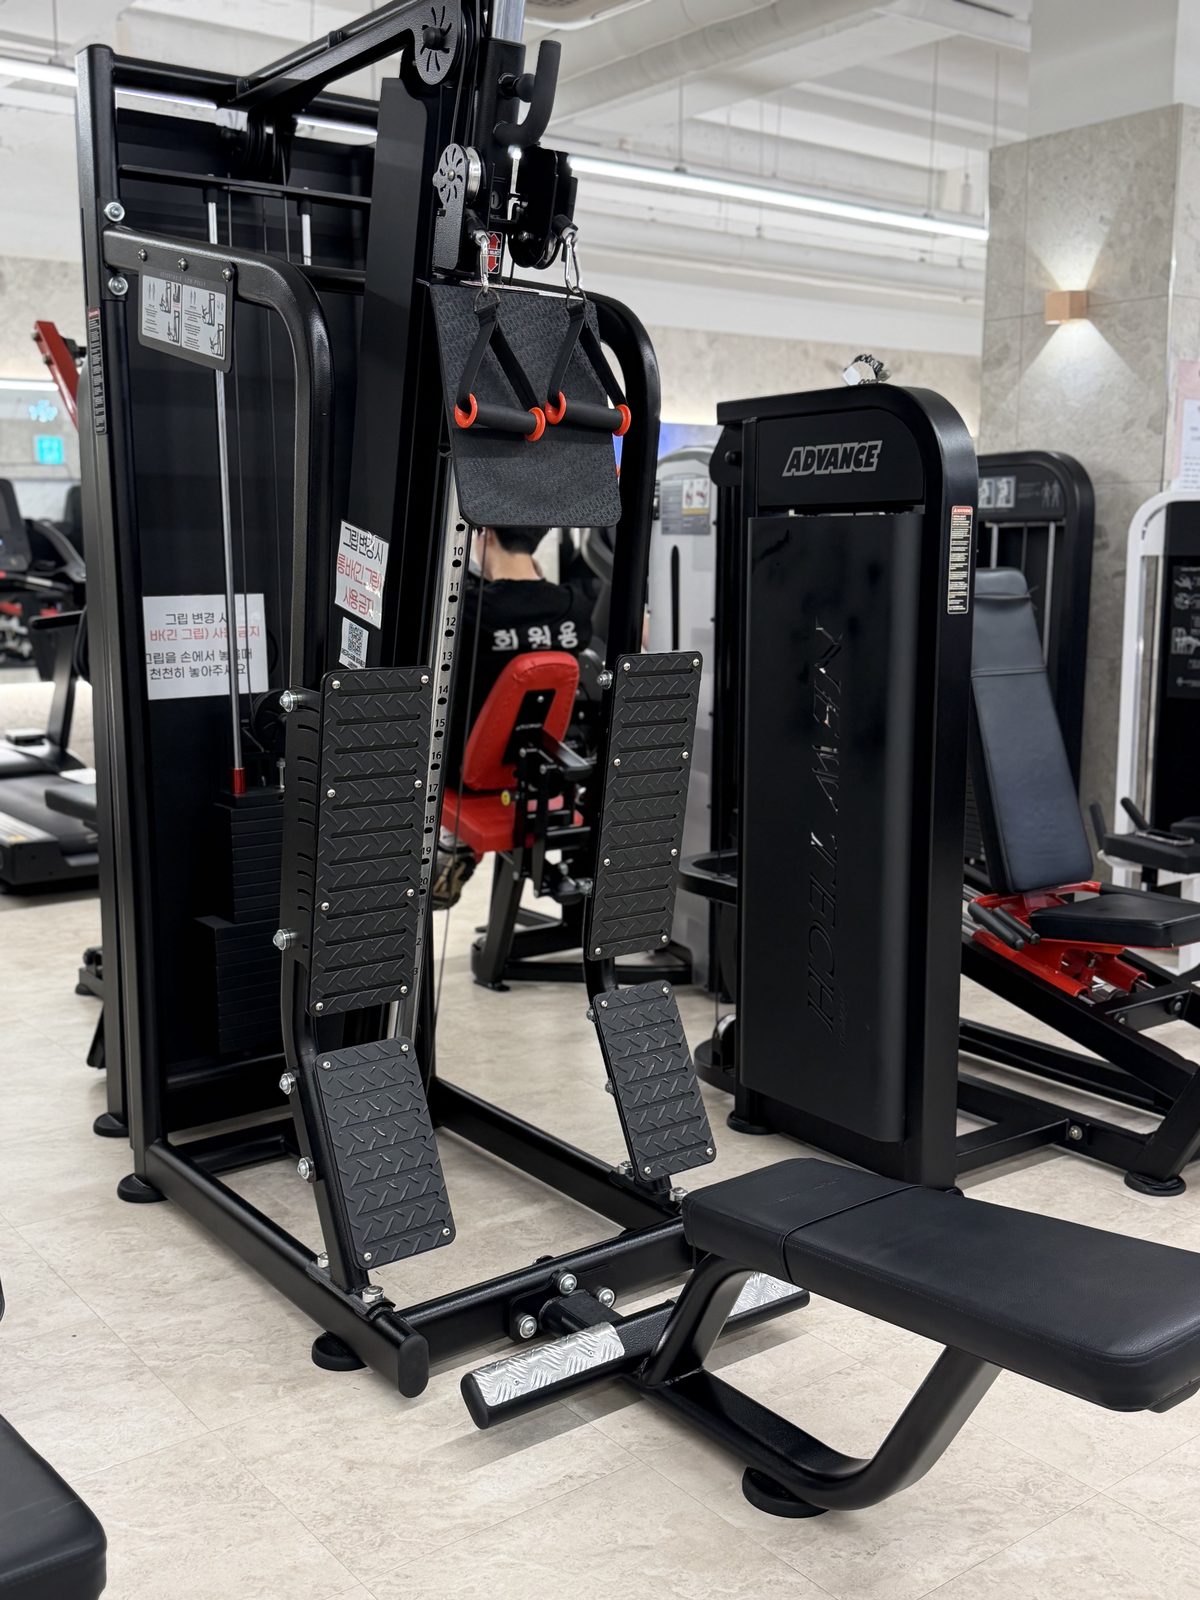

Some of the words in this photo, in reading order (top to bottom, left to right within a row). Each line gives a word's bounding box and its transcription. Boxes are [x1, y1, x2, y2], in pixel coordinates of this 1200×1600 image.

[782, 440, 883, 477] ADVANCE
[453, 547, 464, 556] 10
[450, 582, 459, 591] 11
[165, 613, 188, 625] 그립
[192, 612, 215, 625] 변경
[446, 617, 456, 626] 12
[181, 627, 209, 640] 그립)
[237, 625, 261, 638] 금지
[180, 650, 215, 663] 손에서
[443, 651, 453, 660] 13
[149, 667, 185, 680] 천천히
[439, 685, 449, 694] 14
[811, 616, 843, 815] NEW
[435, 719, 446, 727] 15
[432, 751, 442, 760] 16
[428, 784, 438, 792] 17
[425, 815, 435, 824] 18
[422, 847, 432, 855] 19
[807, 831, 839, 1034] TECH
